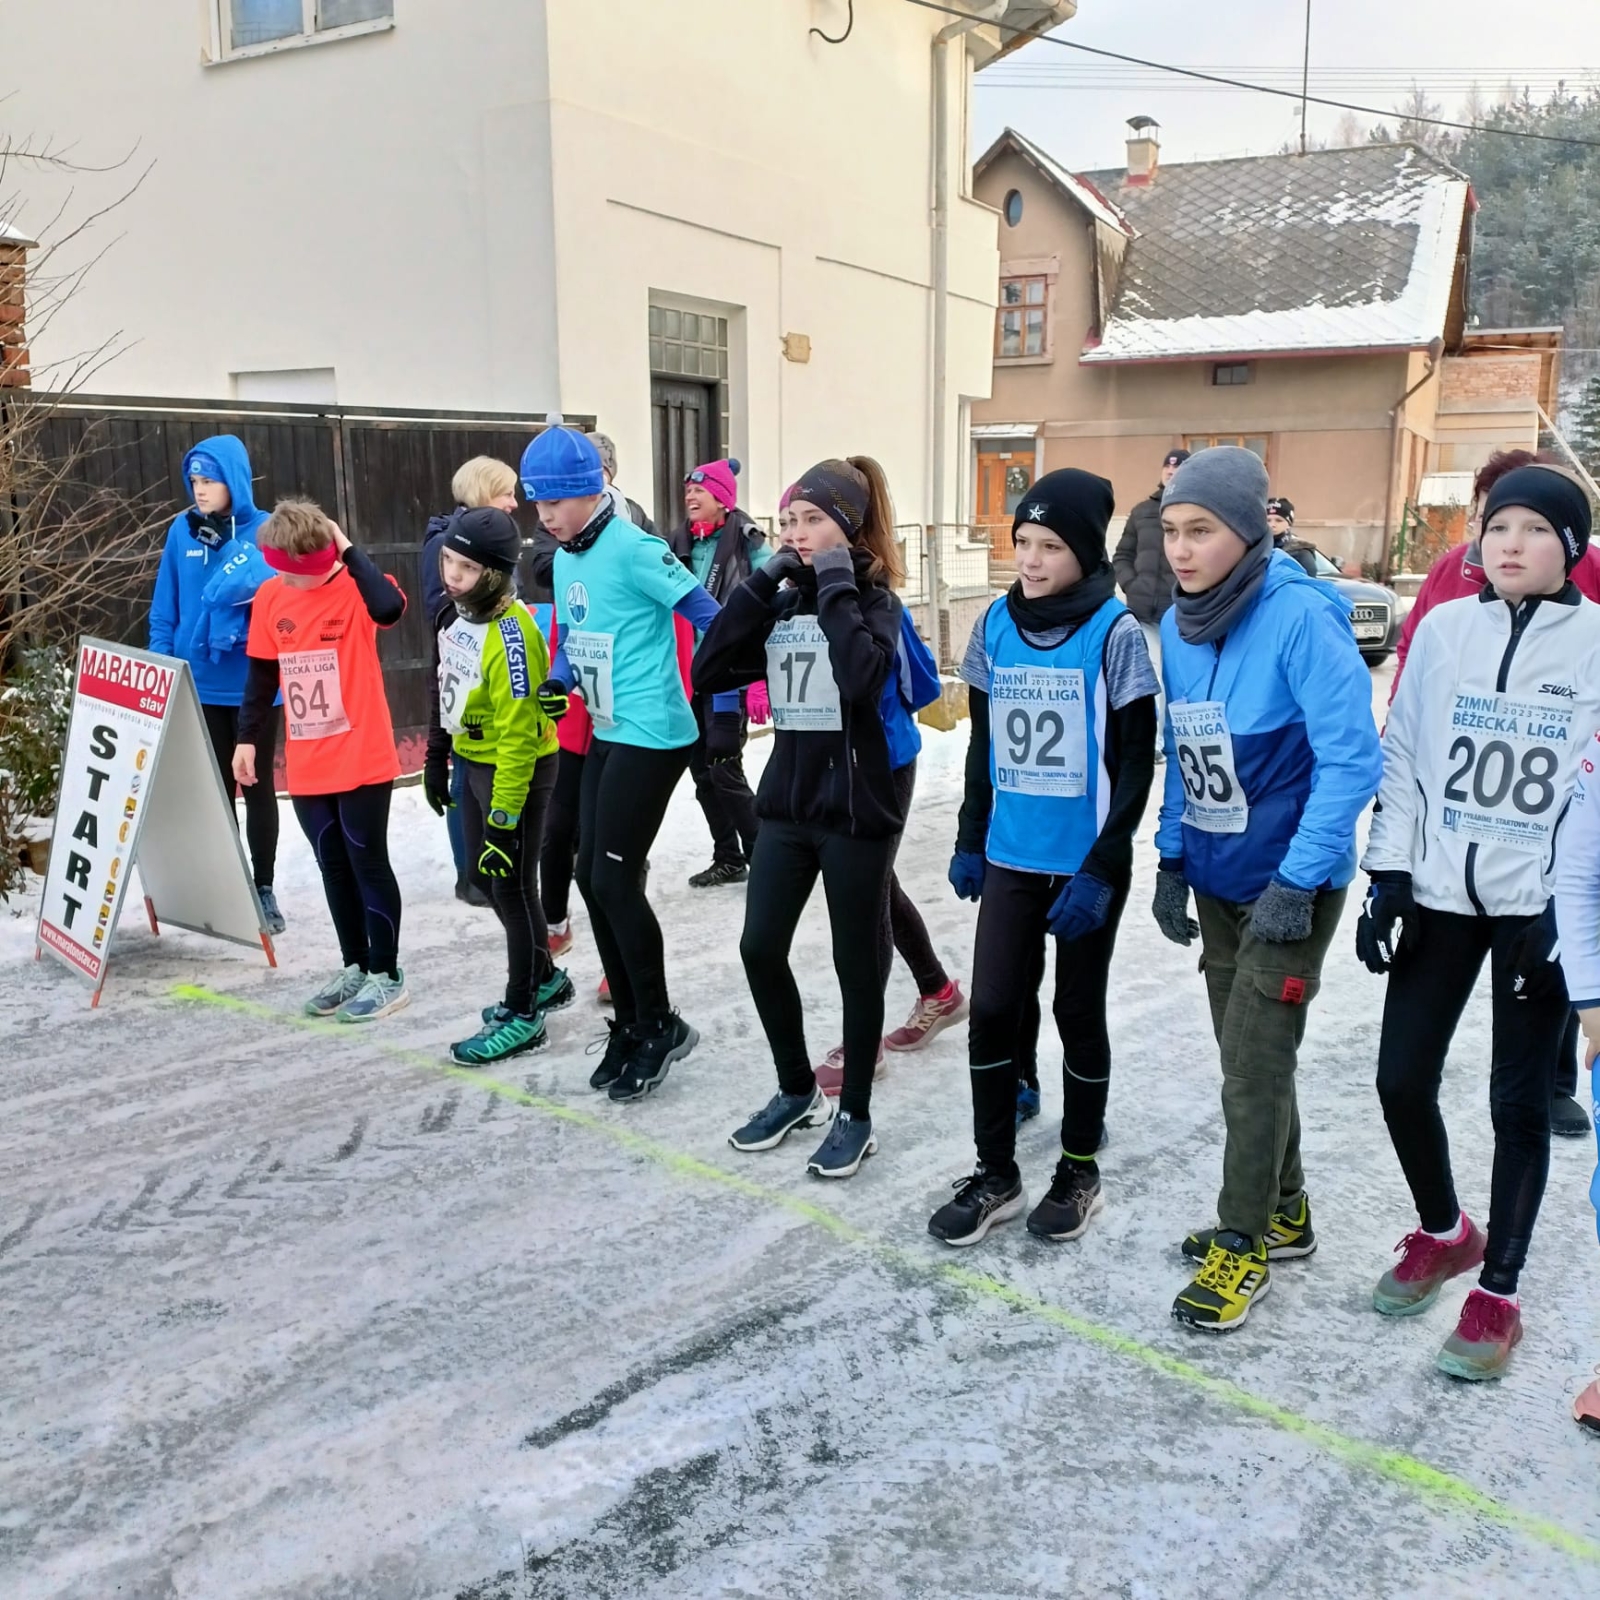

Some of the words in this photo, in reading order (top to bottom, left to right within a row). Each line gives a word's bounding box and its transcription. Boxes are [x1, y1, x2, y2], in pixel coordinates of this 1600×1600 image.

[767, 631, 807, 645] BĚŽECKÁ
[589, 649, 608, 660] LIGA
[81, 647, 175, 698] MARATON
[314, 663, 335, 673] LIGA
[780, 651, 816, 703] 17
[994, 671, 1028, 686] ZIMNÍ
[1031, 678, 1080, 687] 2023-2024
[288, 679, 330, 720] 64
[993, 686, 1043, 701] BĚŽECKÁ
[1048, 689, 1080, 702] LIGA
[139, 696, 165, 713] stav
[1455, 694, 1501, 713] ZIMNÍ
[1174, 712, 1223, 724] 2023-2024
[1503, 706, 1572, 723] 2023-2024
[1192, 722, 1226, 737] LIGA
[1452, 711, 1518, 734] BĚŽECKÁ
[1526, 722, 1568, 741] LIGA
[1006, 707, 1066, 768] 92
[1444, 735, 1559, 816] 208
[1495, 817, 1530, 830] STARTOVNÍ
[1531, 822, 1550, 833] ČÍSLA
[41, 924, 99, 974] www.maratonstav.cz
